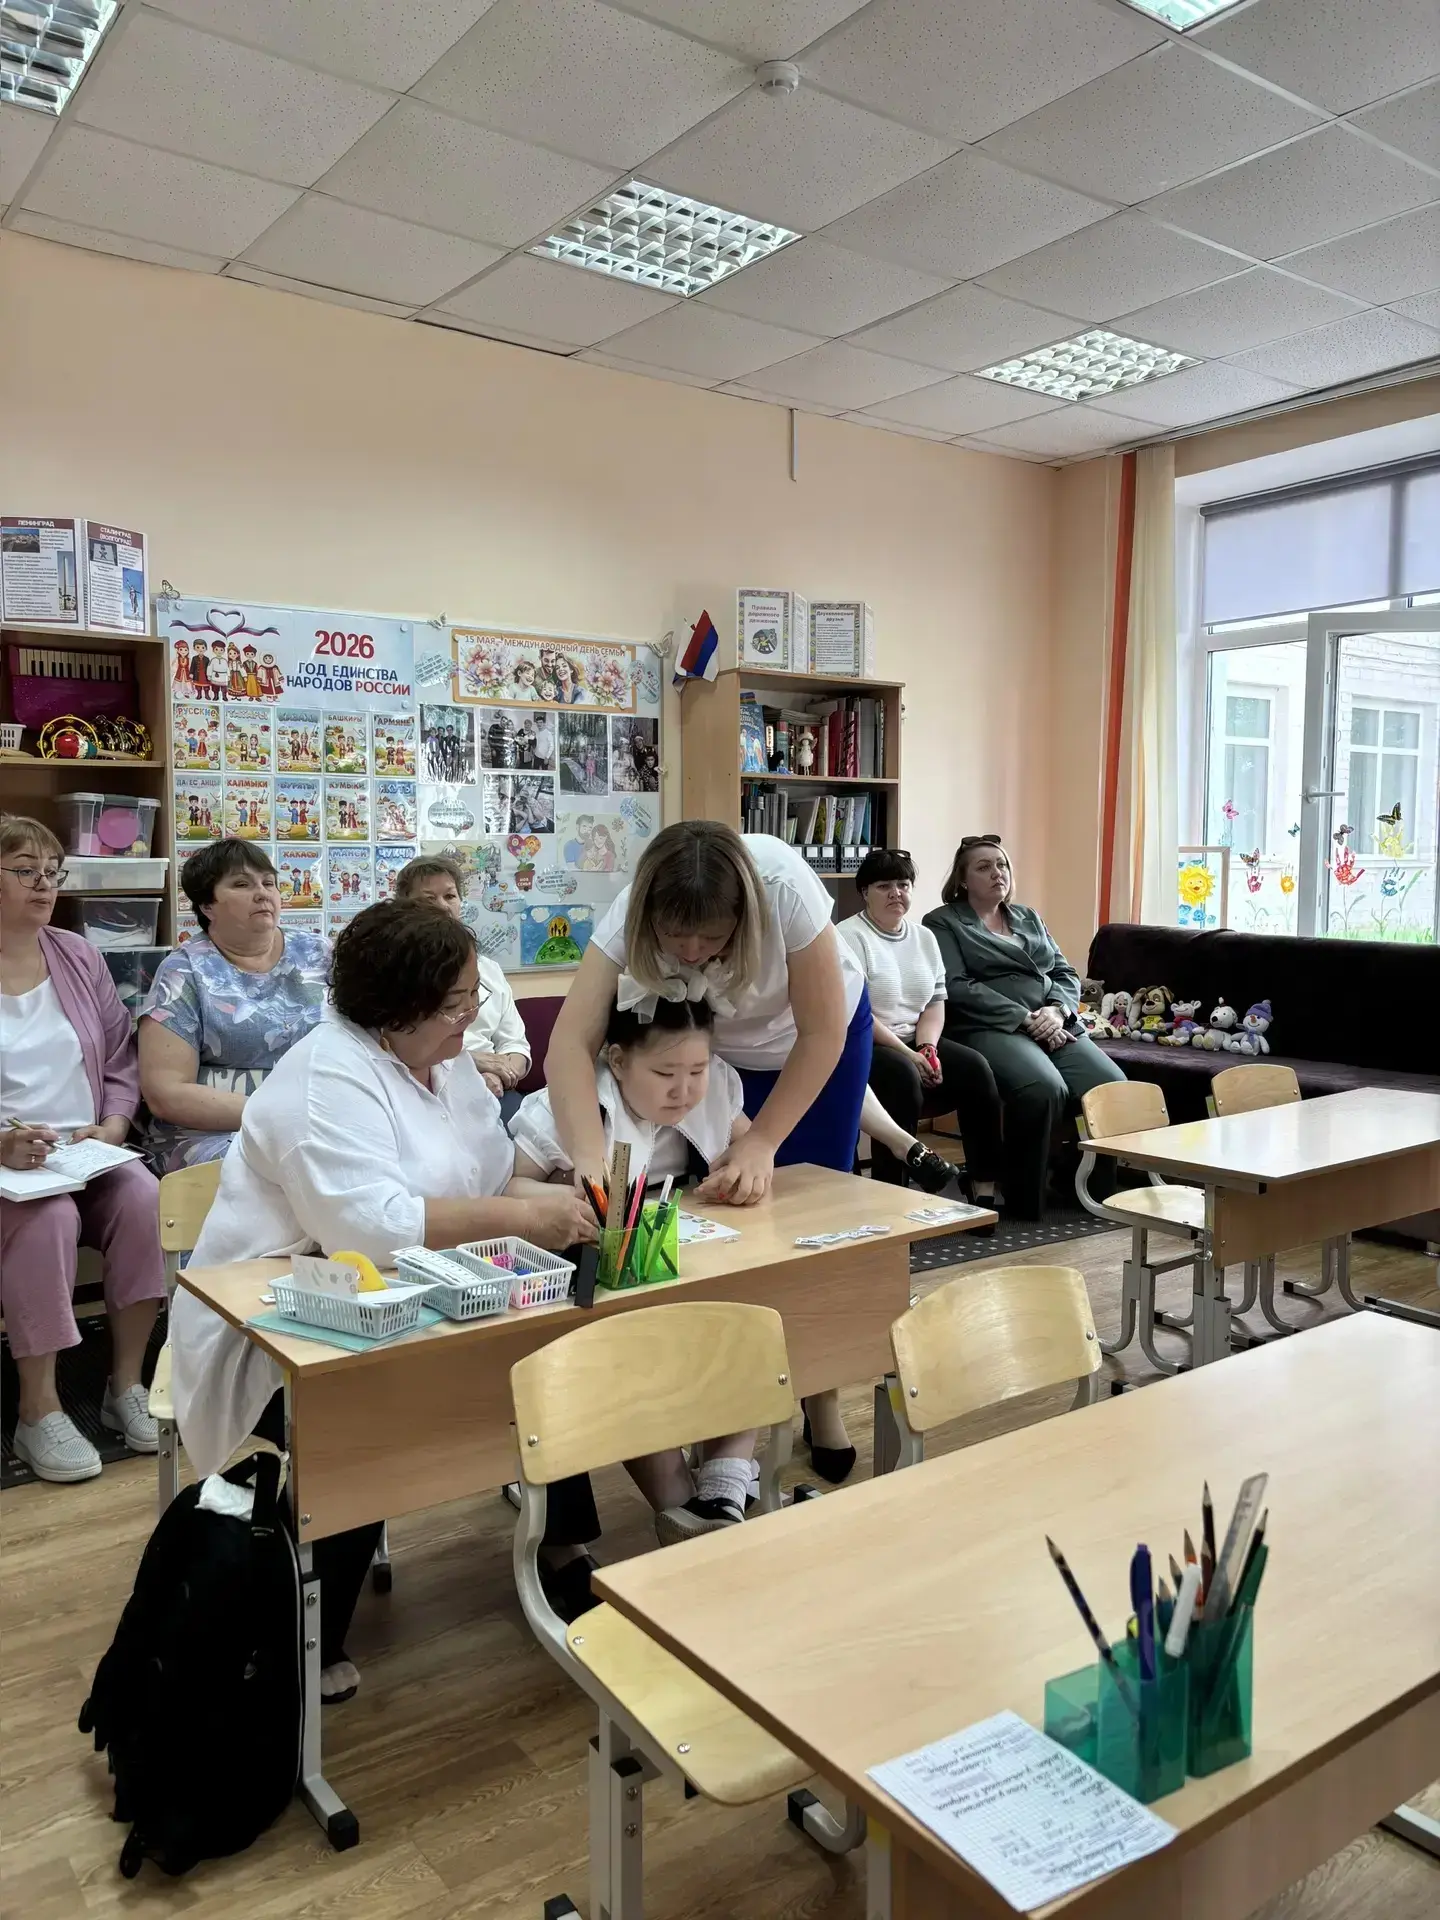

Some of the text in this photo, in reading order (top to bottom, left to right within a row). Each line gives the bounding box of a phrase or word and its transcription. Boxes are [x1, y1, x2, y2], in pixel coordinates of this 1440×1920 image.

[18, 520, 54, 528] ЛЕНИНГРАД
[100, 526, 132, 539] СТАЛИНГРАД
[315, 630, 375, 659] 2026
[477, 636, 496, 645] МАЯ
[504, 638, 578, 653] МЕЖДУНАРОДНЫЙ
[580, 645, 599, 655] ДЕНЬ
[299, 662, 327, 676] ГОД
[332, 664, 398, 682] ЕДИНСТВА
[287, 675, 411, 696] НАРОДОВ РОССИИ
[328, 714, 363, 723] БАШКИРЫ
[226, 779, 268, 788] КАЛМЫКИ
